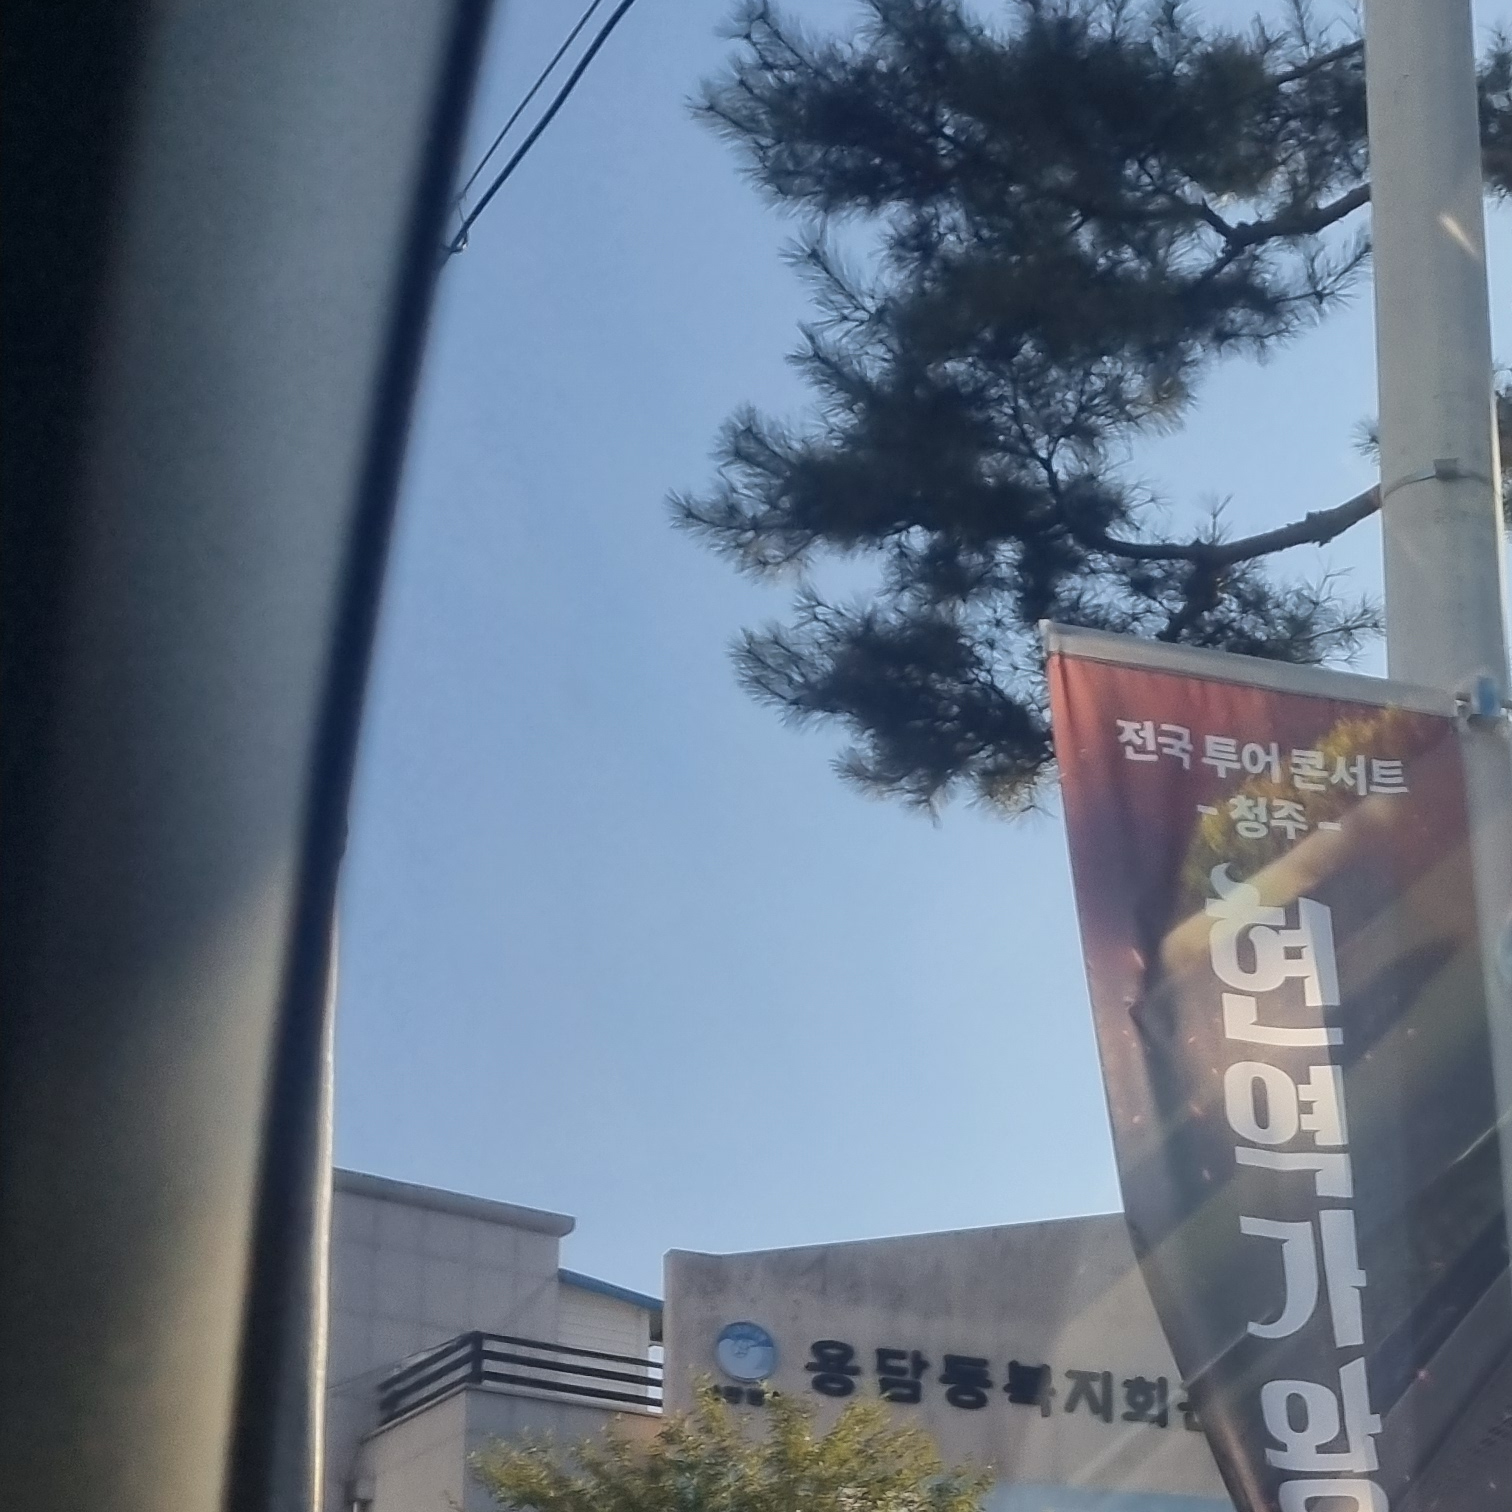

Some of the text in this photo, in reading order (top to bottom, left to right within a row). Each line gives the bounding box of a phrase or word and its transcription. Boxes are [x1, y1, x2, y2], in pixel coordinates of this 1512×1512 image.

[1115, 718, 1410, 797] 전국 투어 콘서트
[1229, 795, 1309, 840] 청주
